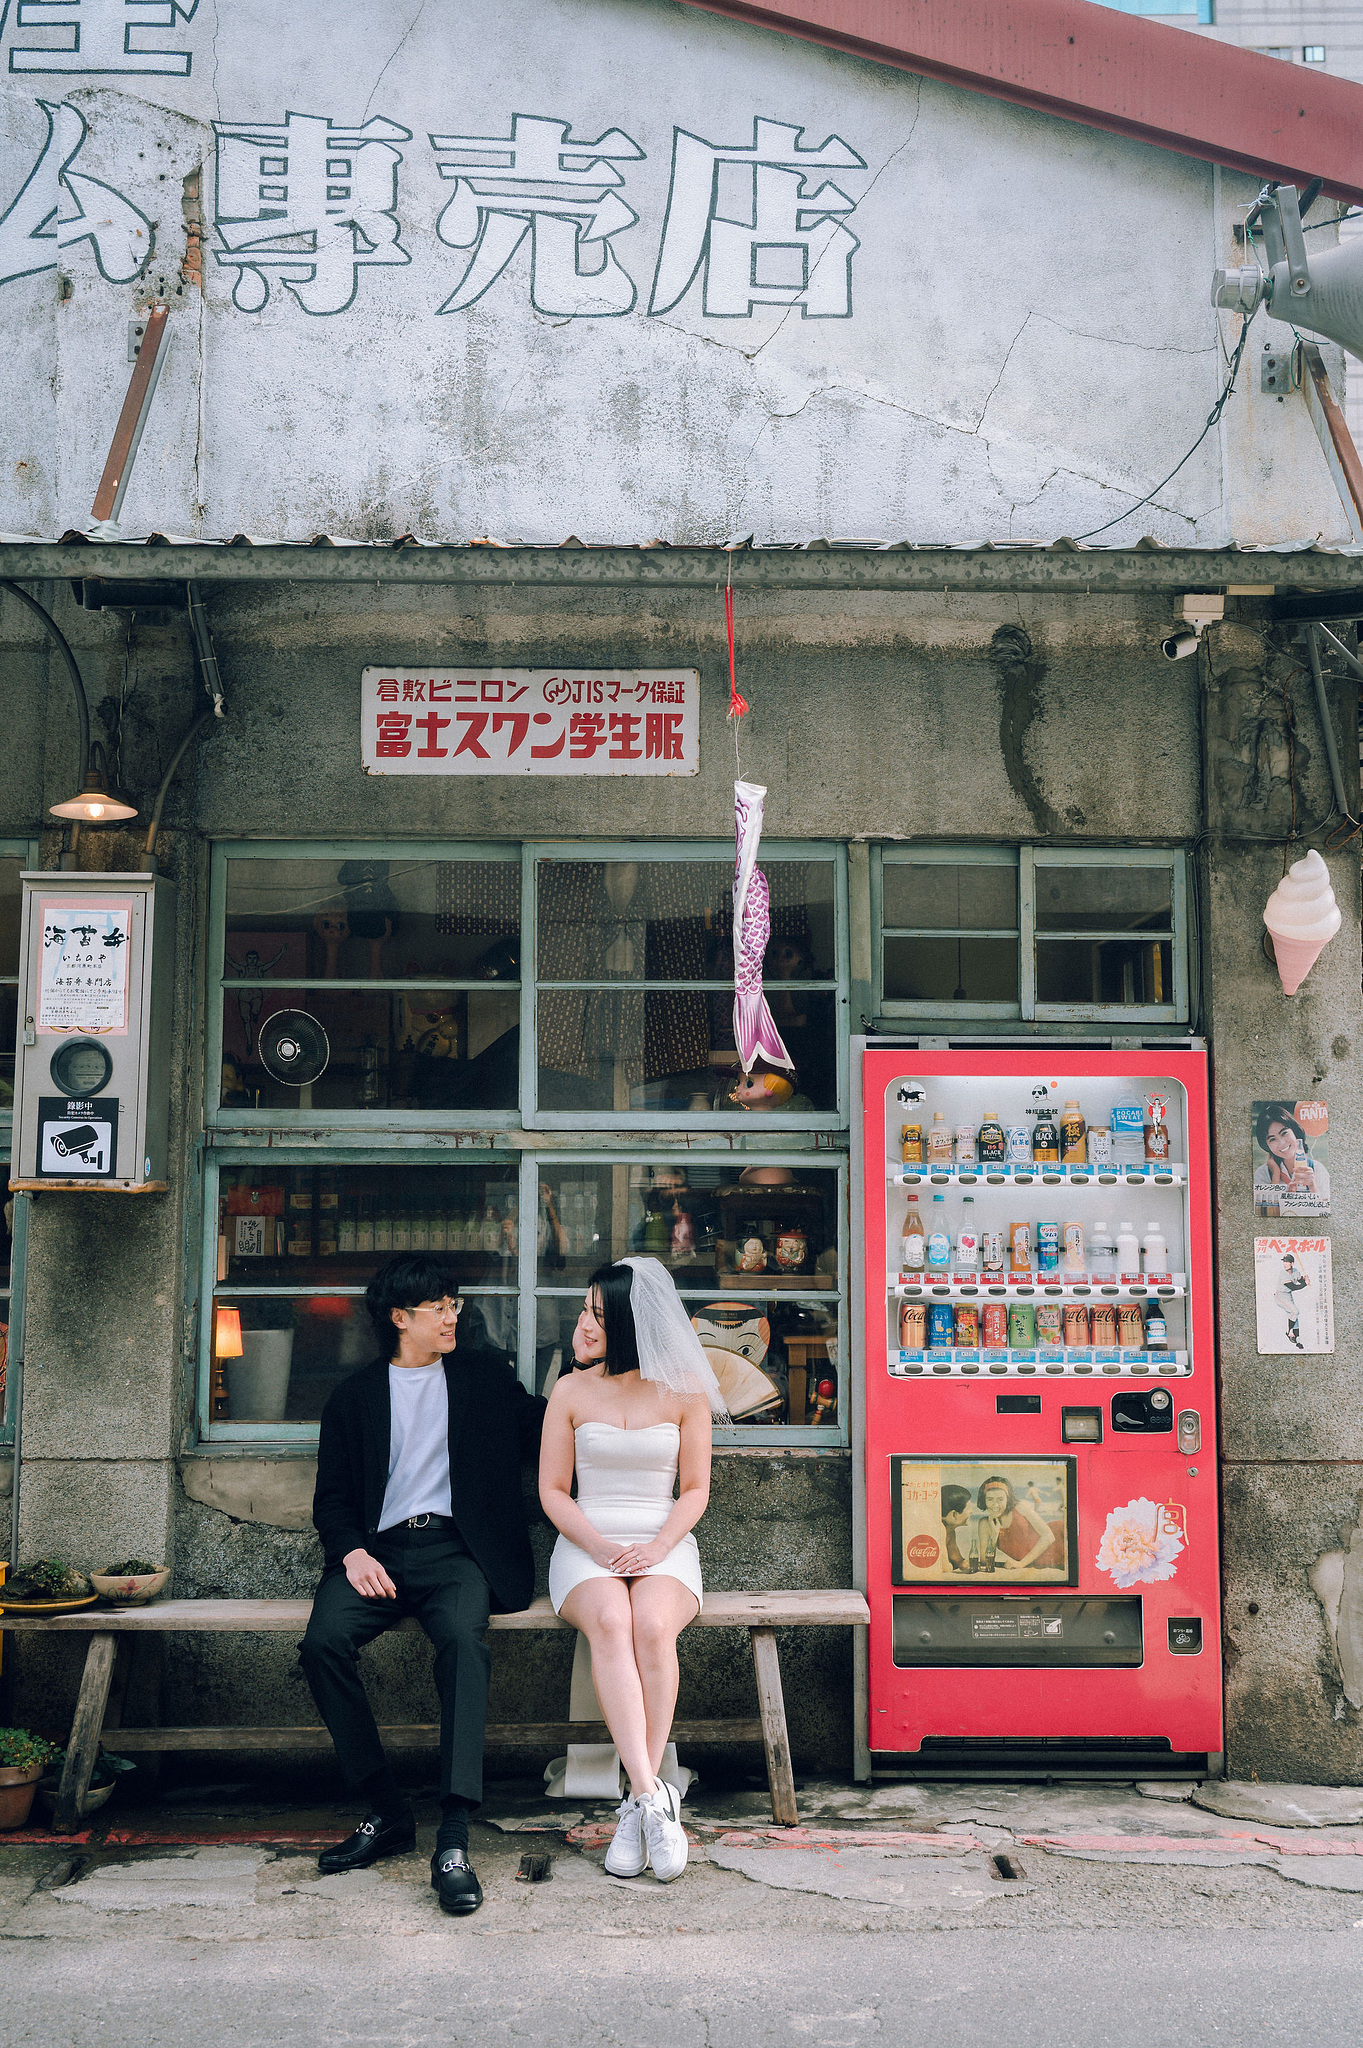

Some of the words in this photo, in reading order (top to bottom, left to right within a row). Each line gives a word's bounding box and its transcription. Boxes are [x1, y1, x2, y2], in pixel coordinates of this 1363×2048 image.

[376, 678, 530, 703] 倉敷ビニロン
[572, 680, 685, 704] JISマーク保証
[375, 711, 685, 760] 富士スワン学生服
[62, 953, 107, 963] いちのや
[1300, 1106, 1328, 1120] FANTA
[1035, 1132, 1053, 1140] BLACK
[1256, 1240, 1268, 1253] 週刊
[1268, 1239, 1326, 1253] ベースボール
[906, 1490, 938, 1500] コカ・コーラ
[909, 1546, 937, 1558] Coca-Cola
